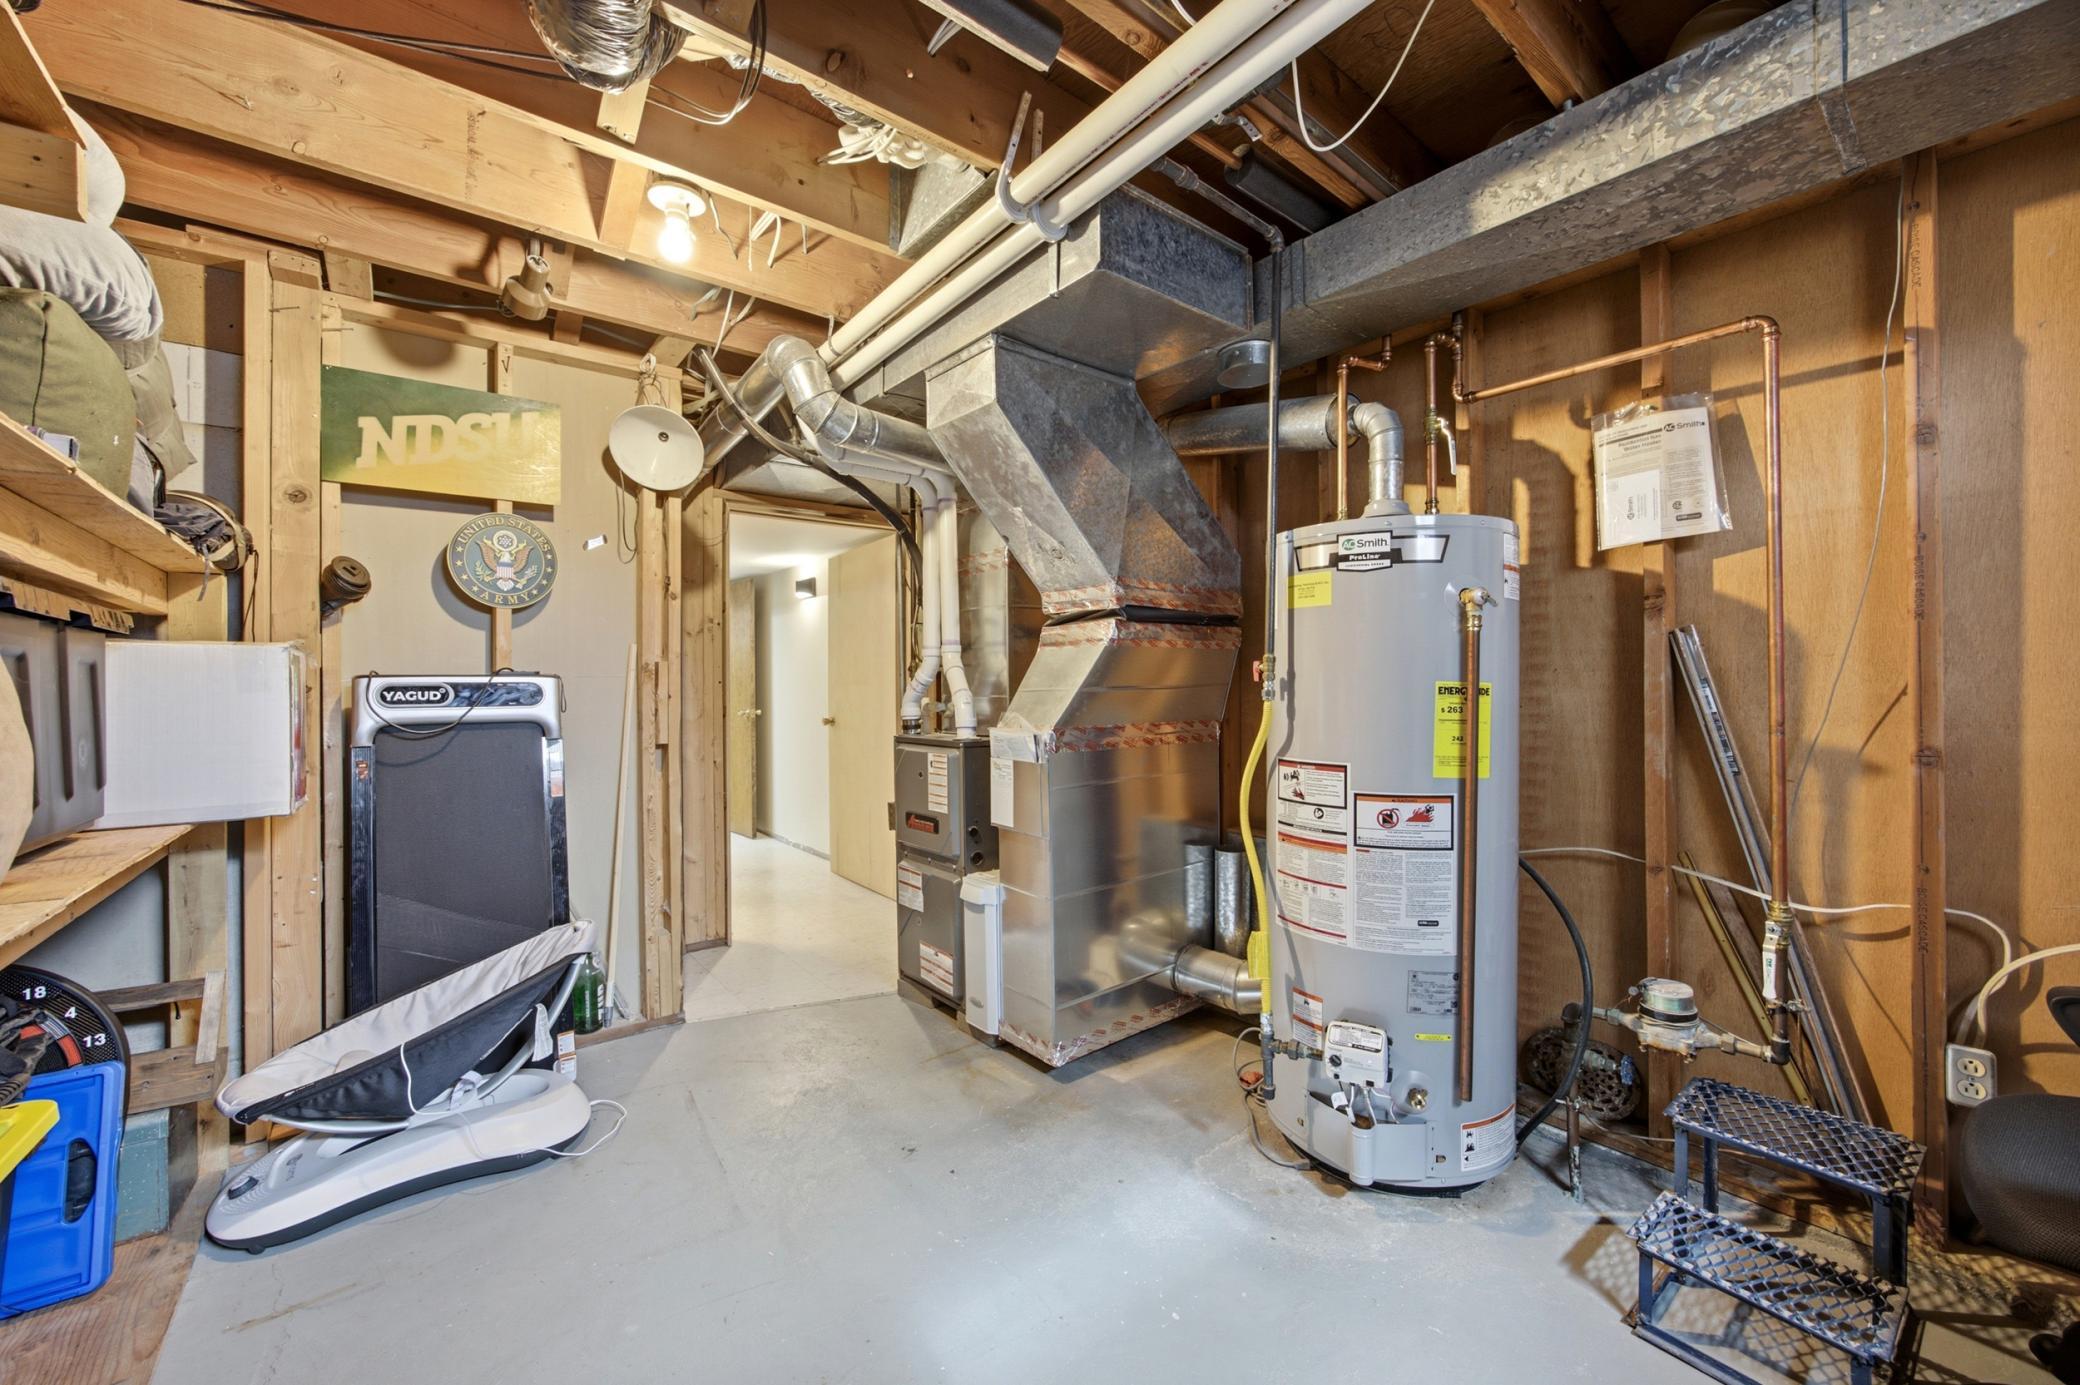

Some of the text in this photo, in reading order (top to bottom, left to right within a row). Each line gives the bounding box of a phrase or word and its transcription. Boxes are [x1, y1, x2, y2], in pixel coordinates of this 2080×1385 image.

[1676, 421, 1702, 430] Smith
[355, 411, 540, 469] NDSU
[458, 516, 551, 552] UNITED STATES
[1357, 538, 1388, 549] Smith
[480, 591, 530, 605] ARMY
[1914, 582, 1925, 620] CASCADE
[383, 689, 442, 702] YAGUD
[1447, 706, 1464, 714] 263
[22, 986, 47, 1000] 18
[64, 1007, 78, 1019] 4
[82, 1033, 107, 1048] 13
